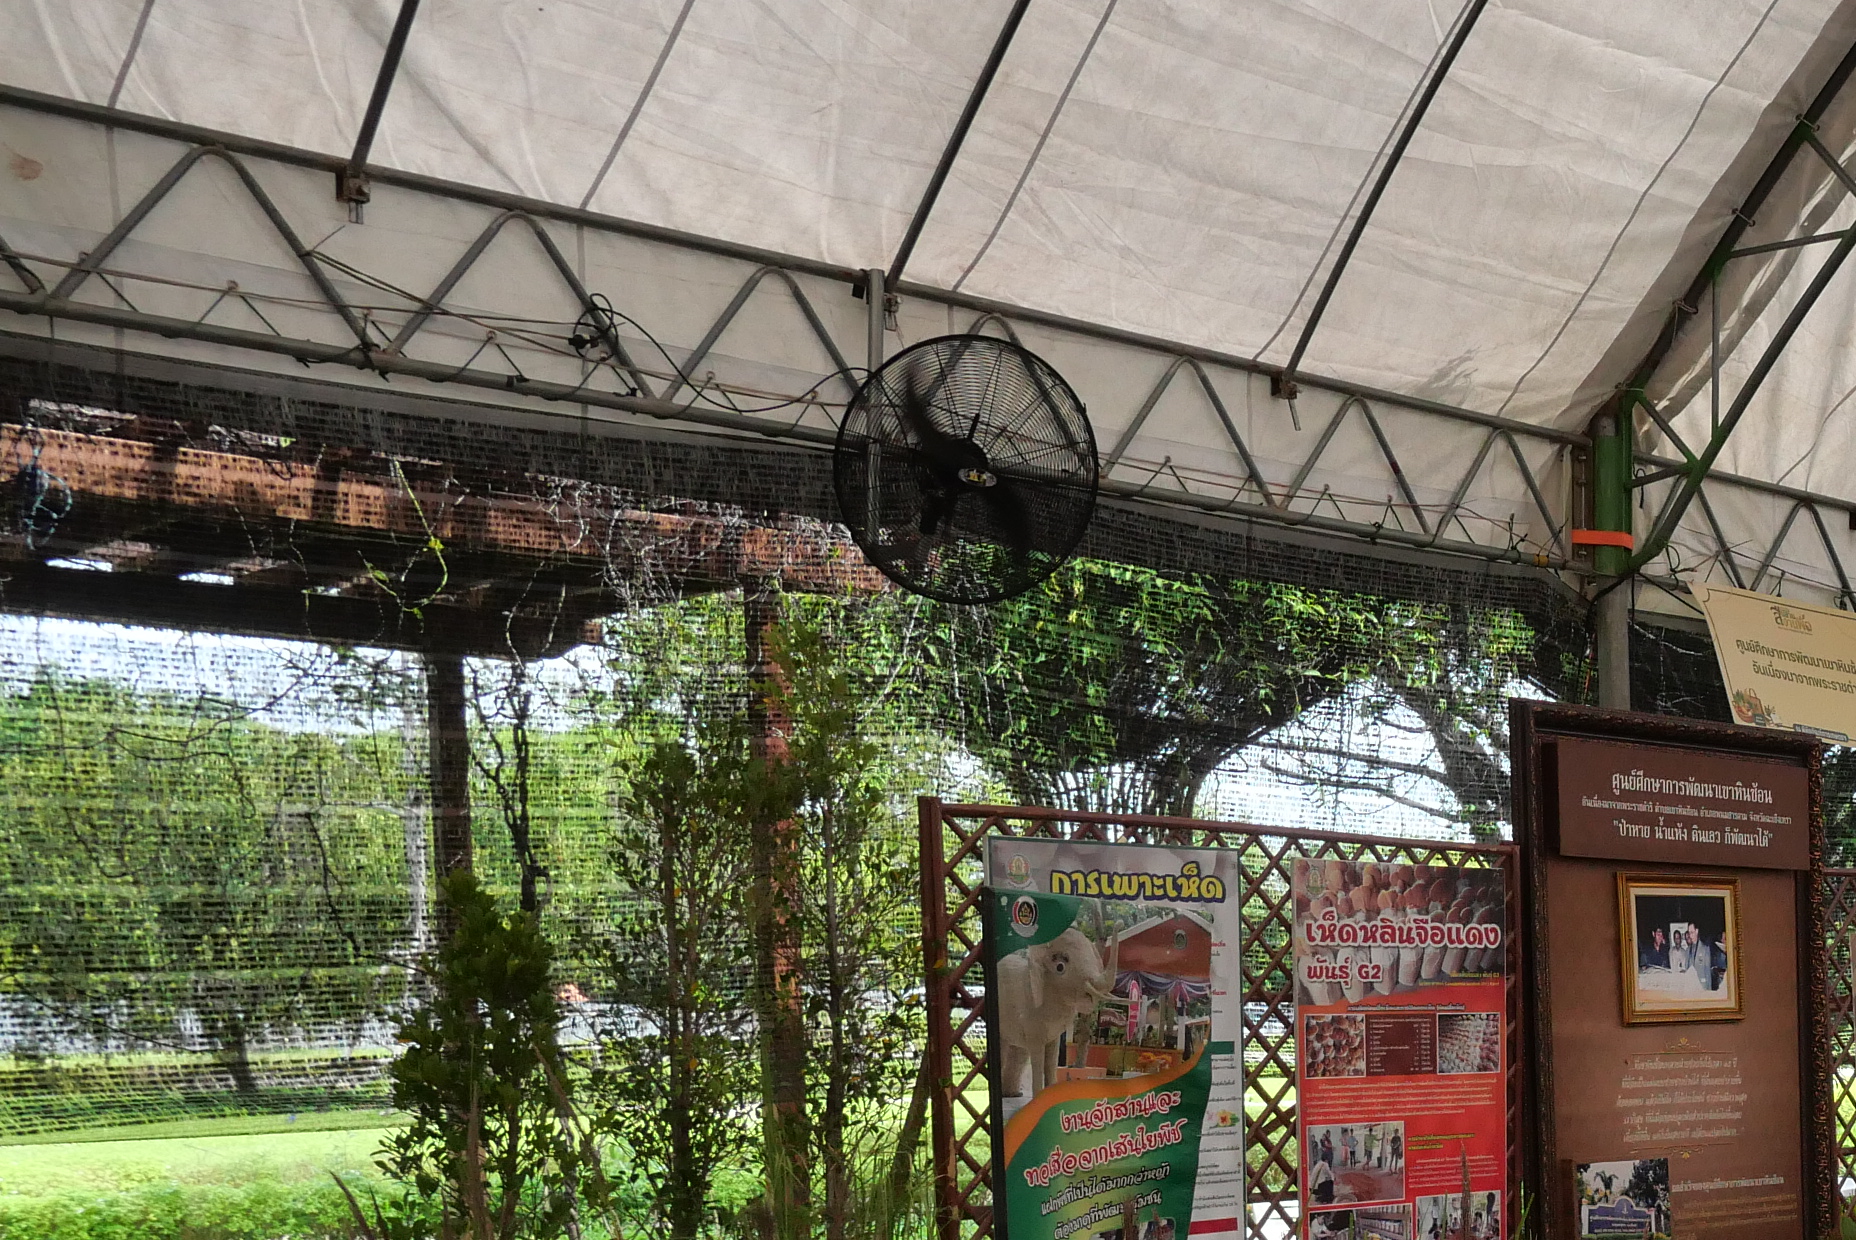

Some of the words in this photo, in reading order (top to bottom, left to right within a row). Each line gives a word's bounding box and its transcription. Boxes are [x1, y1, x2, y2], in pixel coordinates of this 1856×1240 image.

[1612, 769, 1772, 804] ศูนย์ศึกษาการพัฒนาเขาหินซ้อน
[1654, 816, 1687, 841] น้ำแห้ง
[1692, 824, 1720, 843] ดินเลว
[1050, 860, 1226, 903] การเพาะเห็ด
[1305, 907, 1501, 948] เห็ดหลินจือแดง
[1306, 954, 1352, 988] พันธุ์
[1356, 962, 1383, 983] G2
[1060, 1090, 1181, 1133] งานจักสานและ
[1024, 1118, 1187, 1187] ทอเสื่อจากเส้นใยพืช
